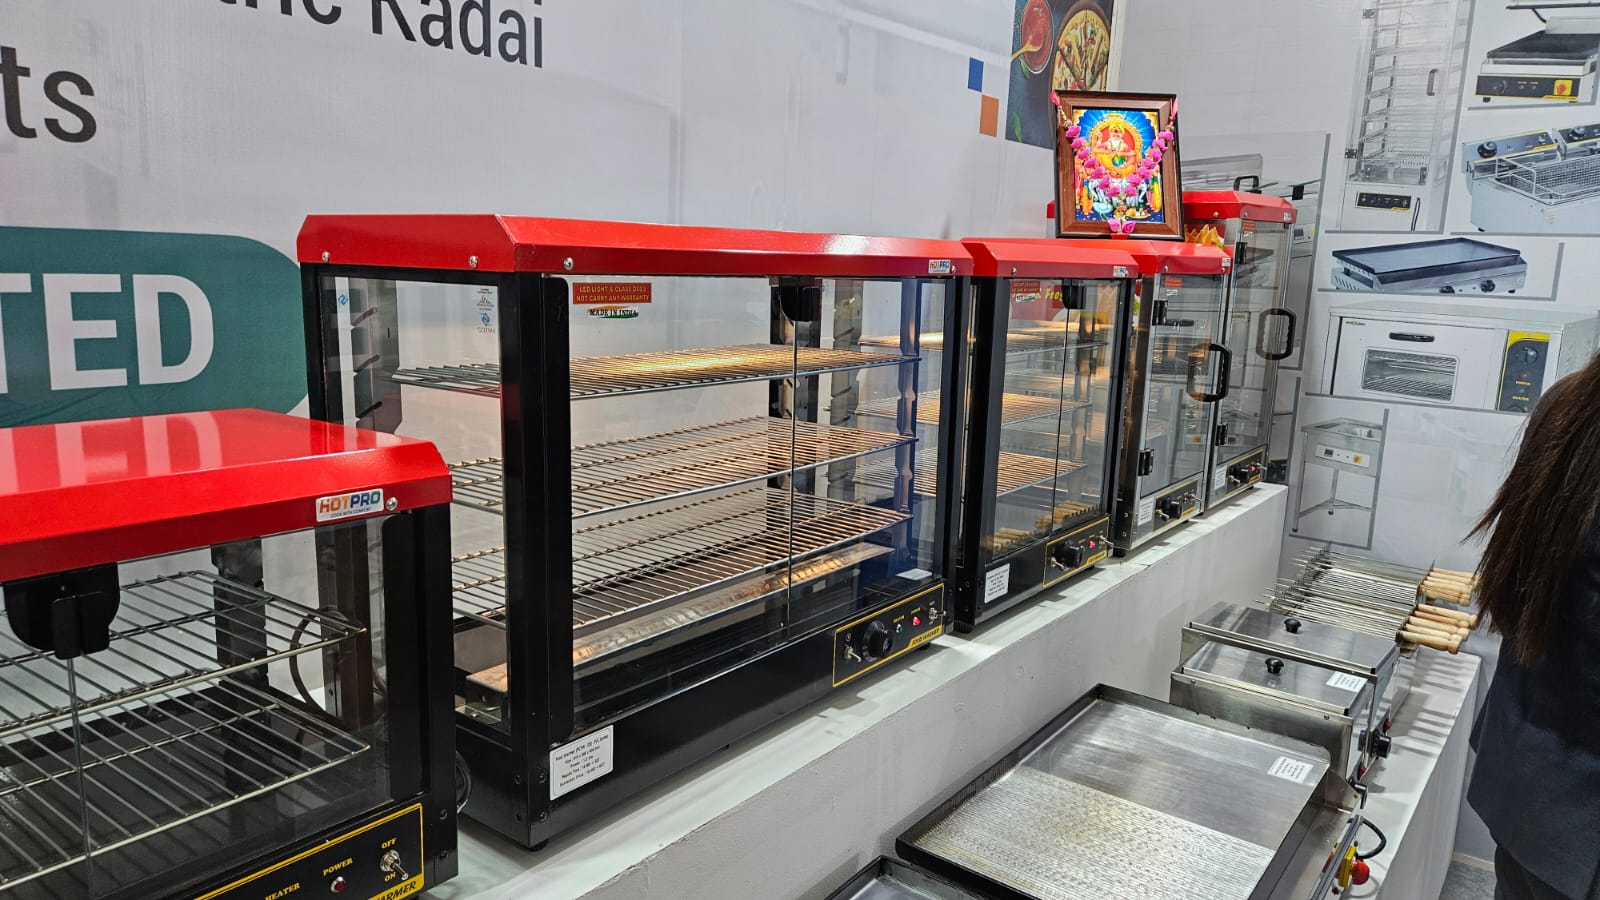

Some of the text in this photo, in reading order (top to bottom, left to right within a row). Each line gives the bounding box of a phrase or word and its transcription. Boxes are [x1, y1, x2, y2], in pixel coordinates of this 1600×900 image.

[371, 0, 542, 68] Kadai
[0, 45, 97, 143] ts
[579, 285, 591, 293] LED
[591, 285, 608, 293] LIGHT
[589, 308, 608, 316] MADE
[610, 308, 617, 316] IN
[320, 490, 381, 513] HOTPRO
[381, 837, 398, 849] OFF
[322, 857, 353, 876] POWER
[384, 871, 397, 882] ON
[265, 882, 300, 900] HEATER
